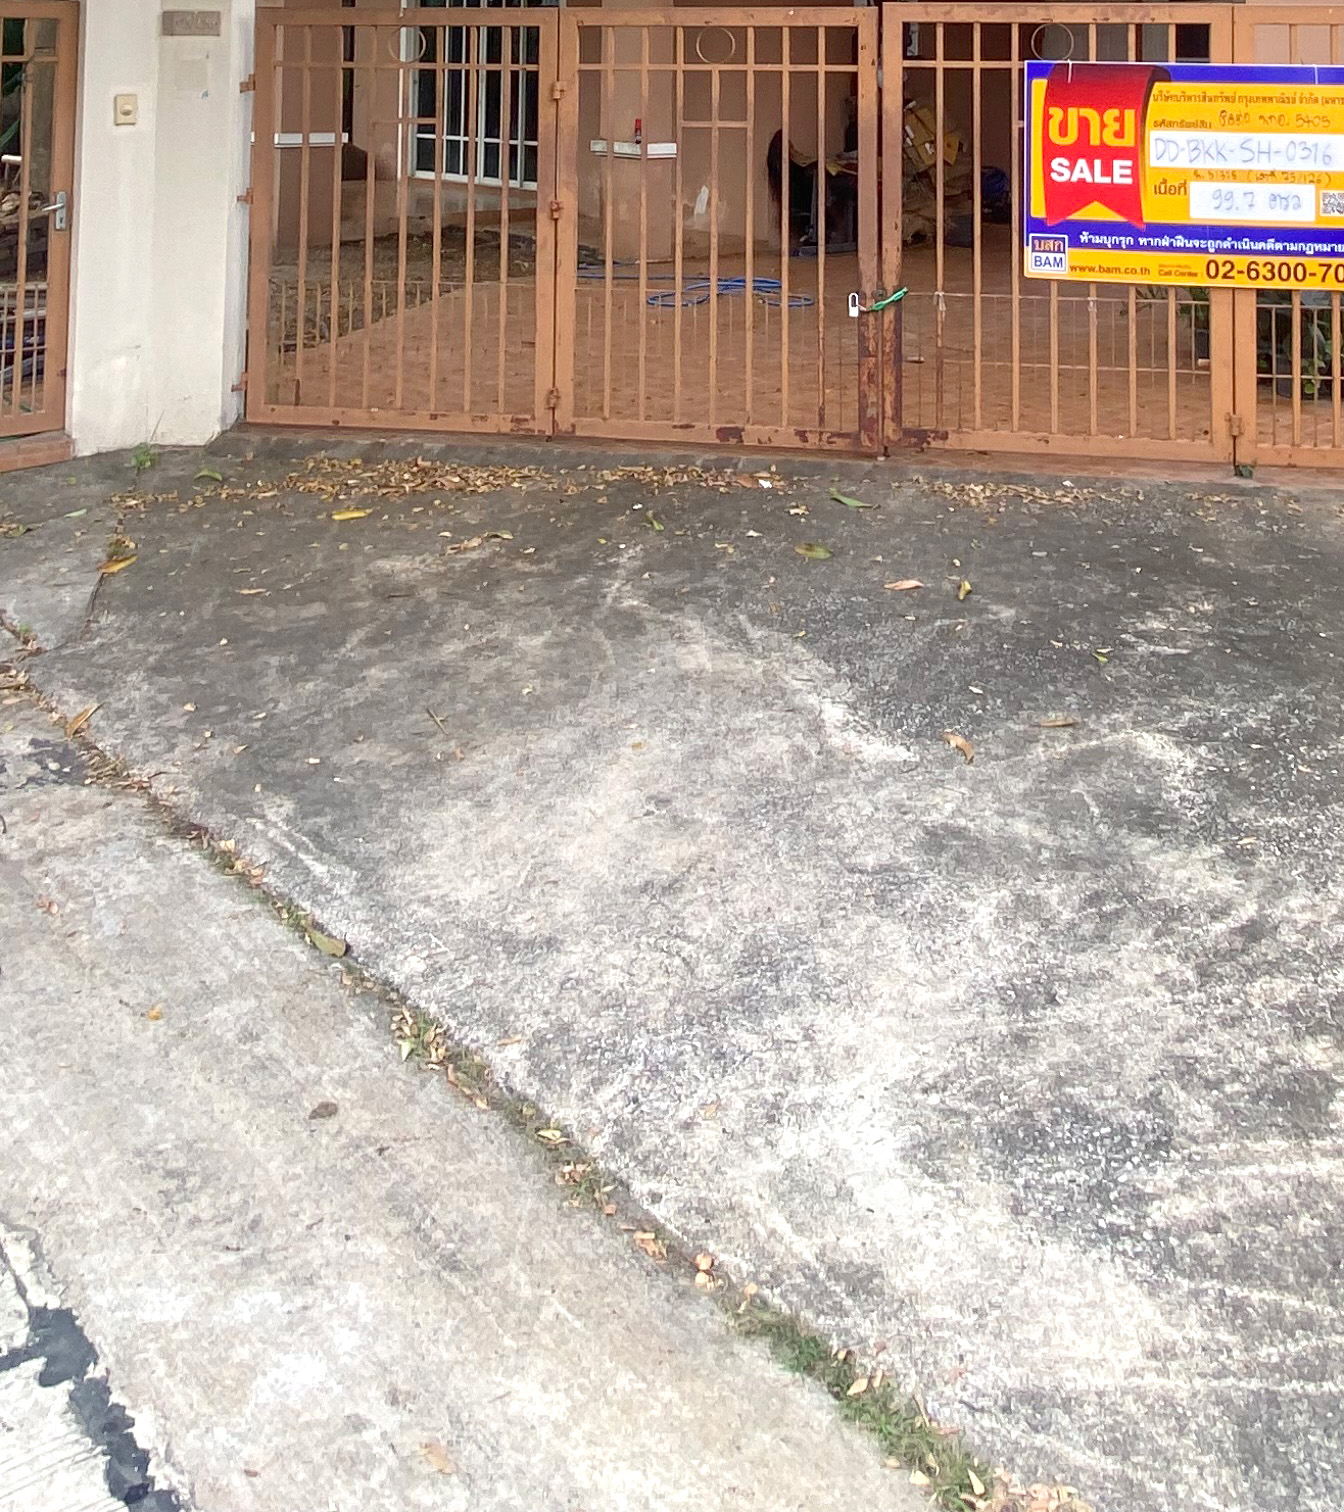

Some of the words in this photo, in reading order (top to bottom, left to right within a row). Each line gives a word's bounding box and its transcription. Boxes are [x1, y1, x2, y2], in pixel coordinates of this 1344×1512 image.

[1048, 107, 1136, 147] ขาย
[1050, 157, 1133, 185] SALE
[1154, 178, 1187, 196] เนื้อที่
[1034, 238, 1063, 252] บสก
[1080, 232, 1134, 247] ห้ามบุกรุก
[1034, 255, 1063, 269] BAM
[1069, 263, 1151, 276] www.bam.co.th
